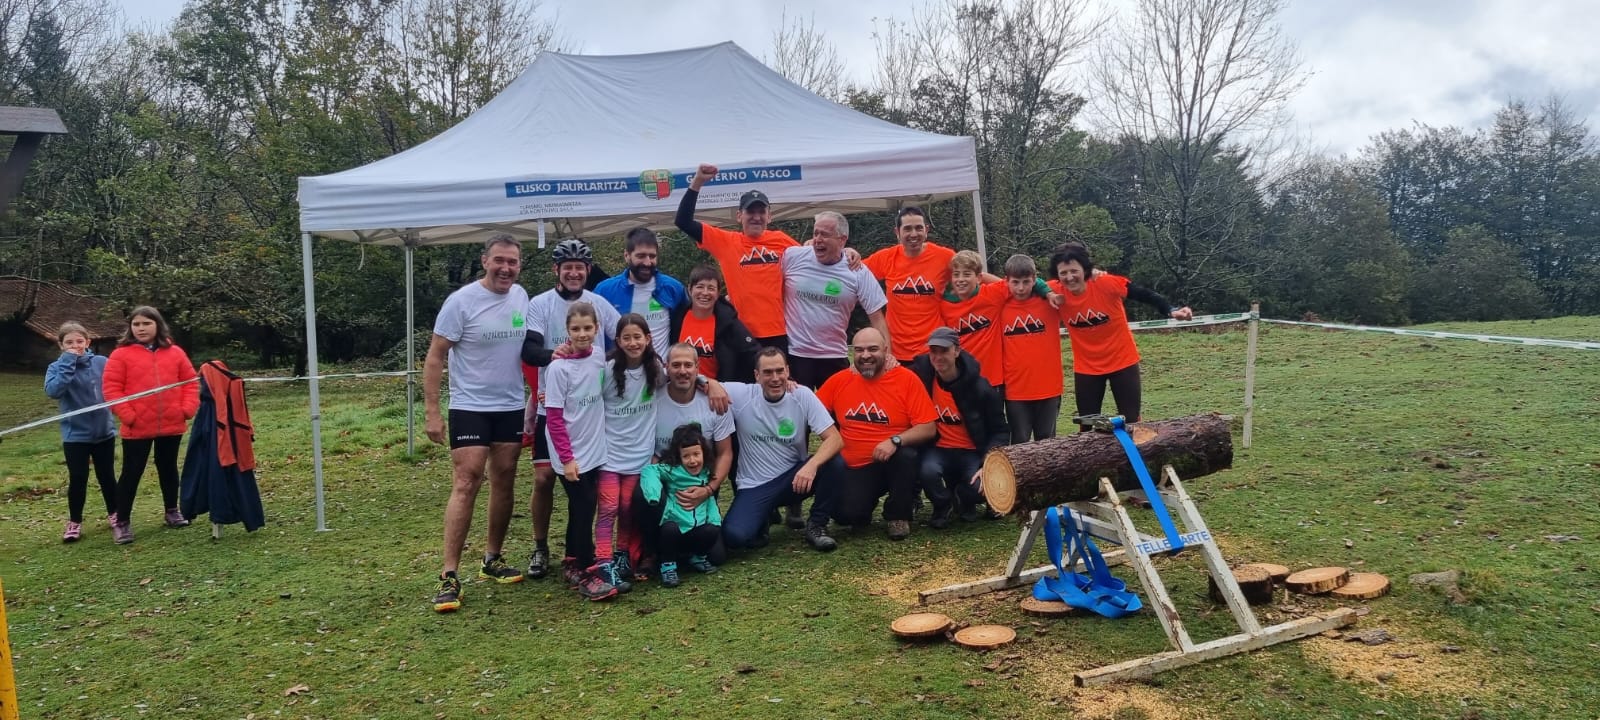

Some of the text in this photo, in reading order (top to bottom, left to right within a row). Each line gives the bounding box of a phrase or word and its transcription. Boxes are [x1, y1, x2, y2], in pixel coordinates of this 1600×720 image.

[686, 169, 791, 184] GERNO VASCO
[515, 180, 628, 194] EUSKO JAURLARITZA
[1136, 530, 1210, 554] TELLEARTE
